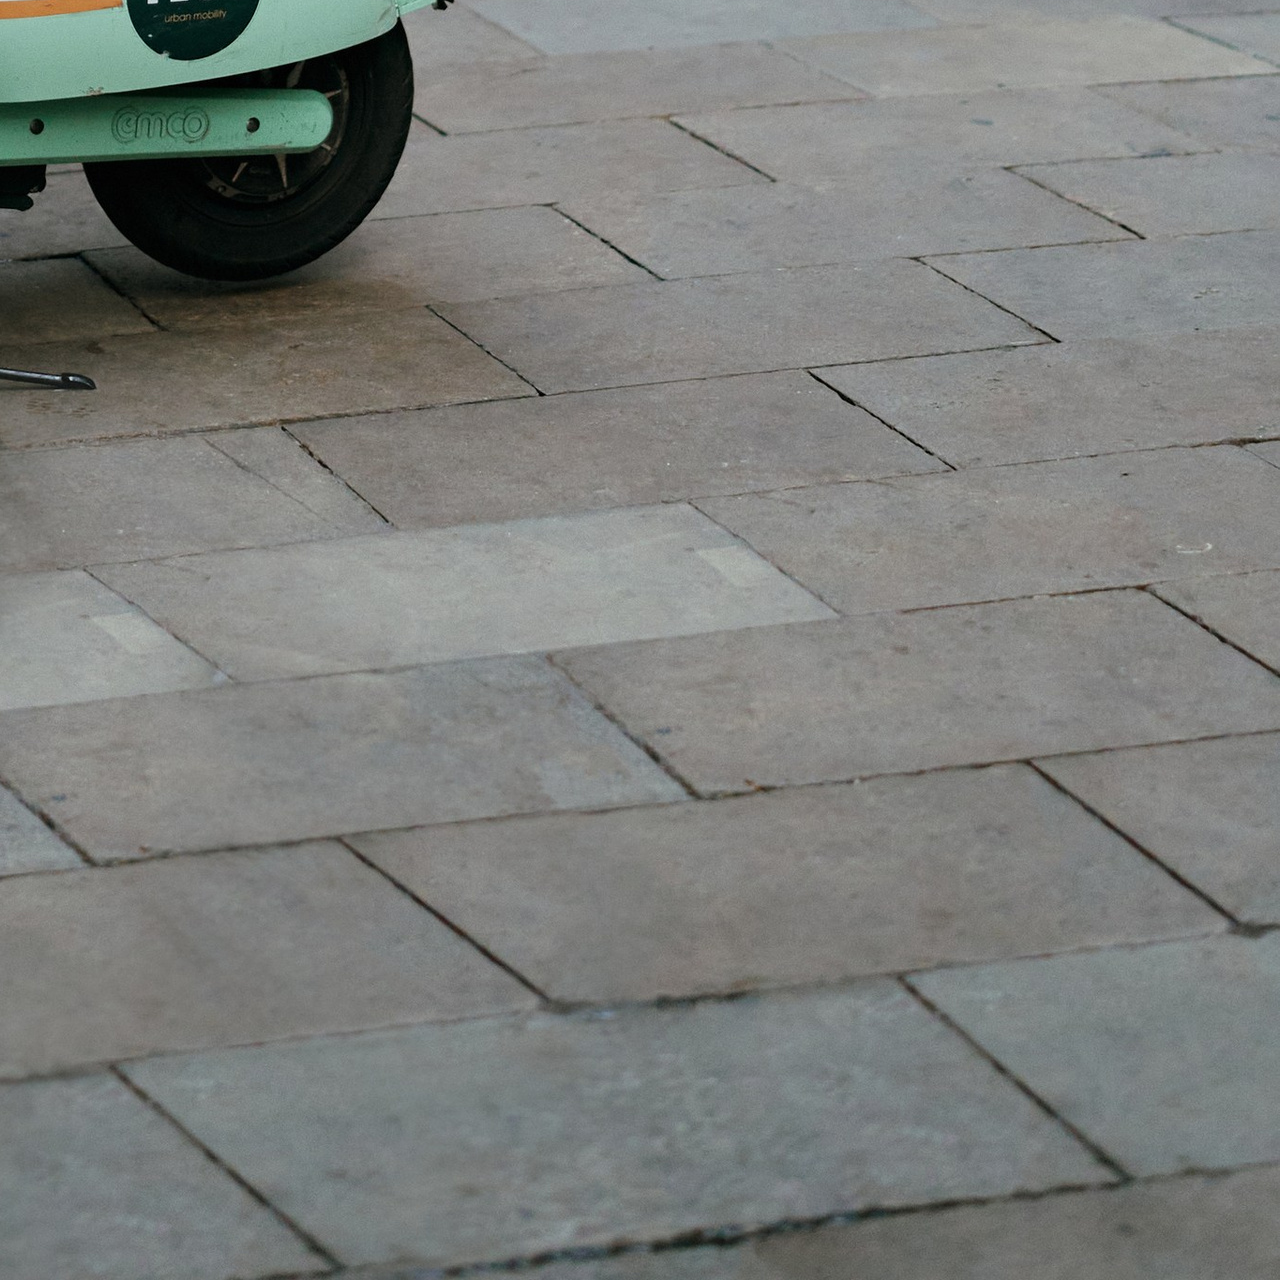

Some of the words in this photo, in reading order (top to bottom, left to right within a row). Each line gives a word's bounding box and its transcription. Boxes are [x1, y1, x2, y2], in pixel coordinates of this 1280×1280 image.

[164, 12, 192, 23] urban
[193, 9, 228, 21] mobility
[111, 106, 210, 144] emco
